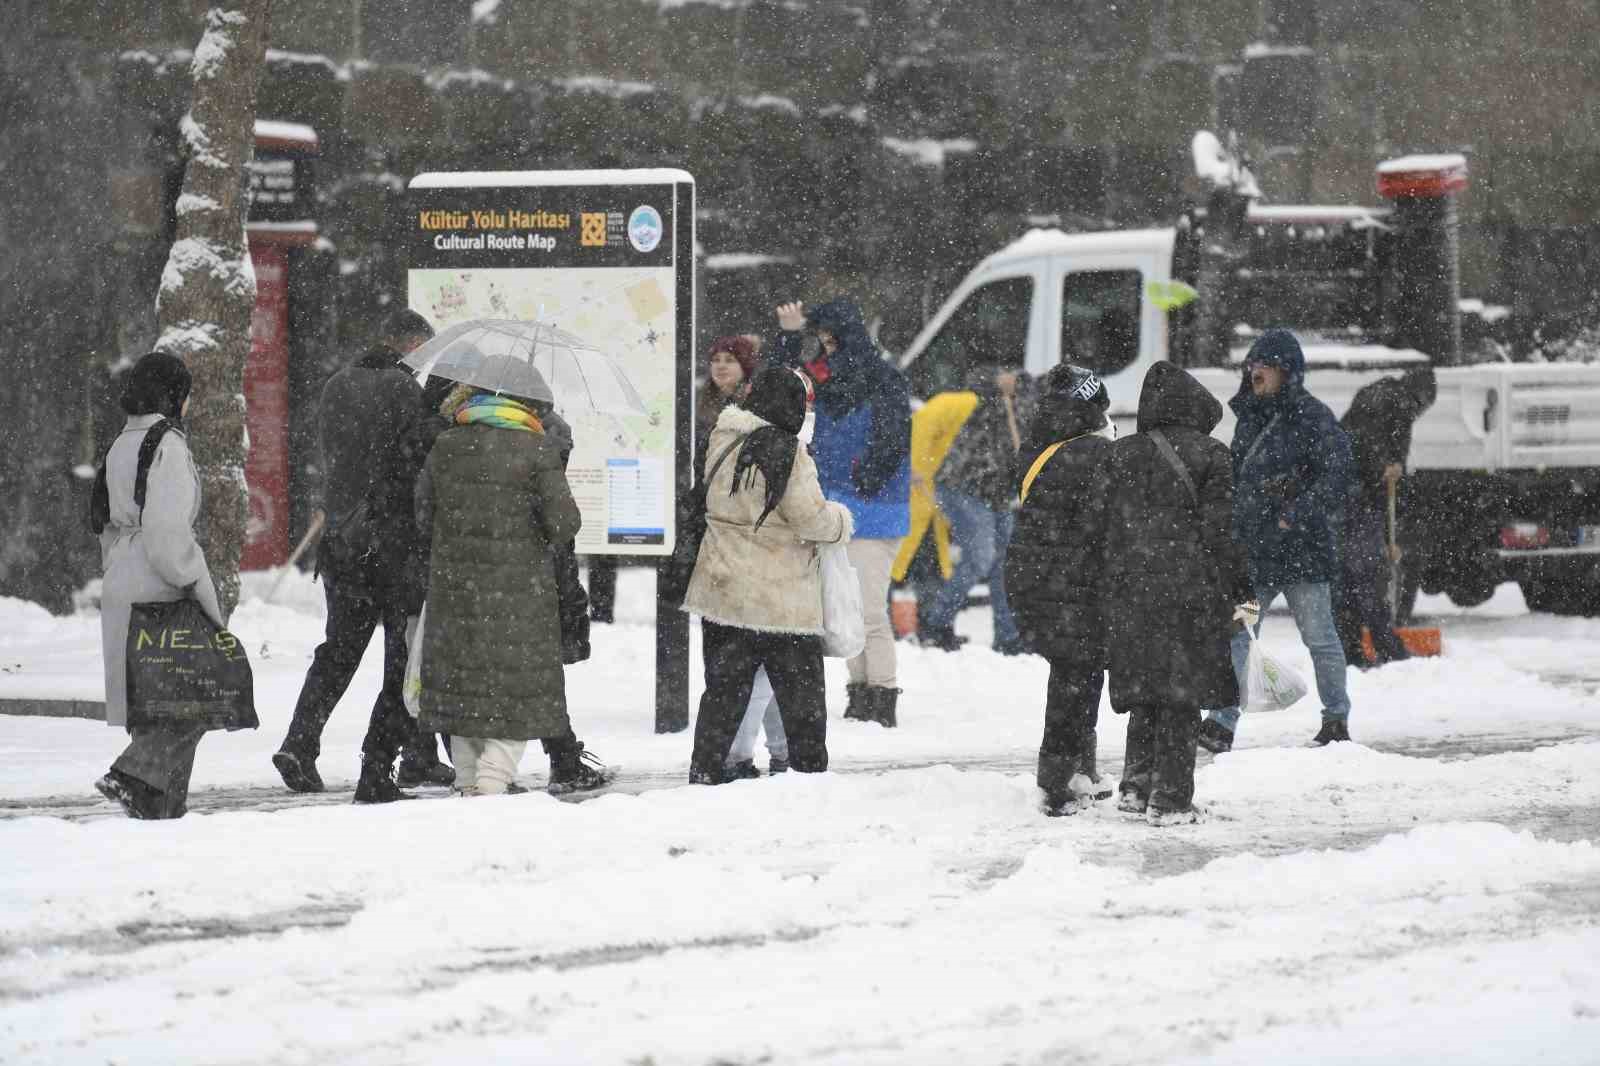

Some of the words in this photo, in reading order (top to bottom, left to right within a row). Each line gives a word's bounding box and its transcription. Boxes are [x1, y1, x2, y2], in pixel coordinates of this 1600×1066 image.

[420, 210, 469, 230] Kültür
[471, 211, 504, 229] Yolu
[509, 209, 571, 229] Haritası
[433, 234, 485, 251] Cultural
[487, 234, 525, 250] Route
[527, 233, 556, 253] Map
